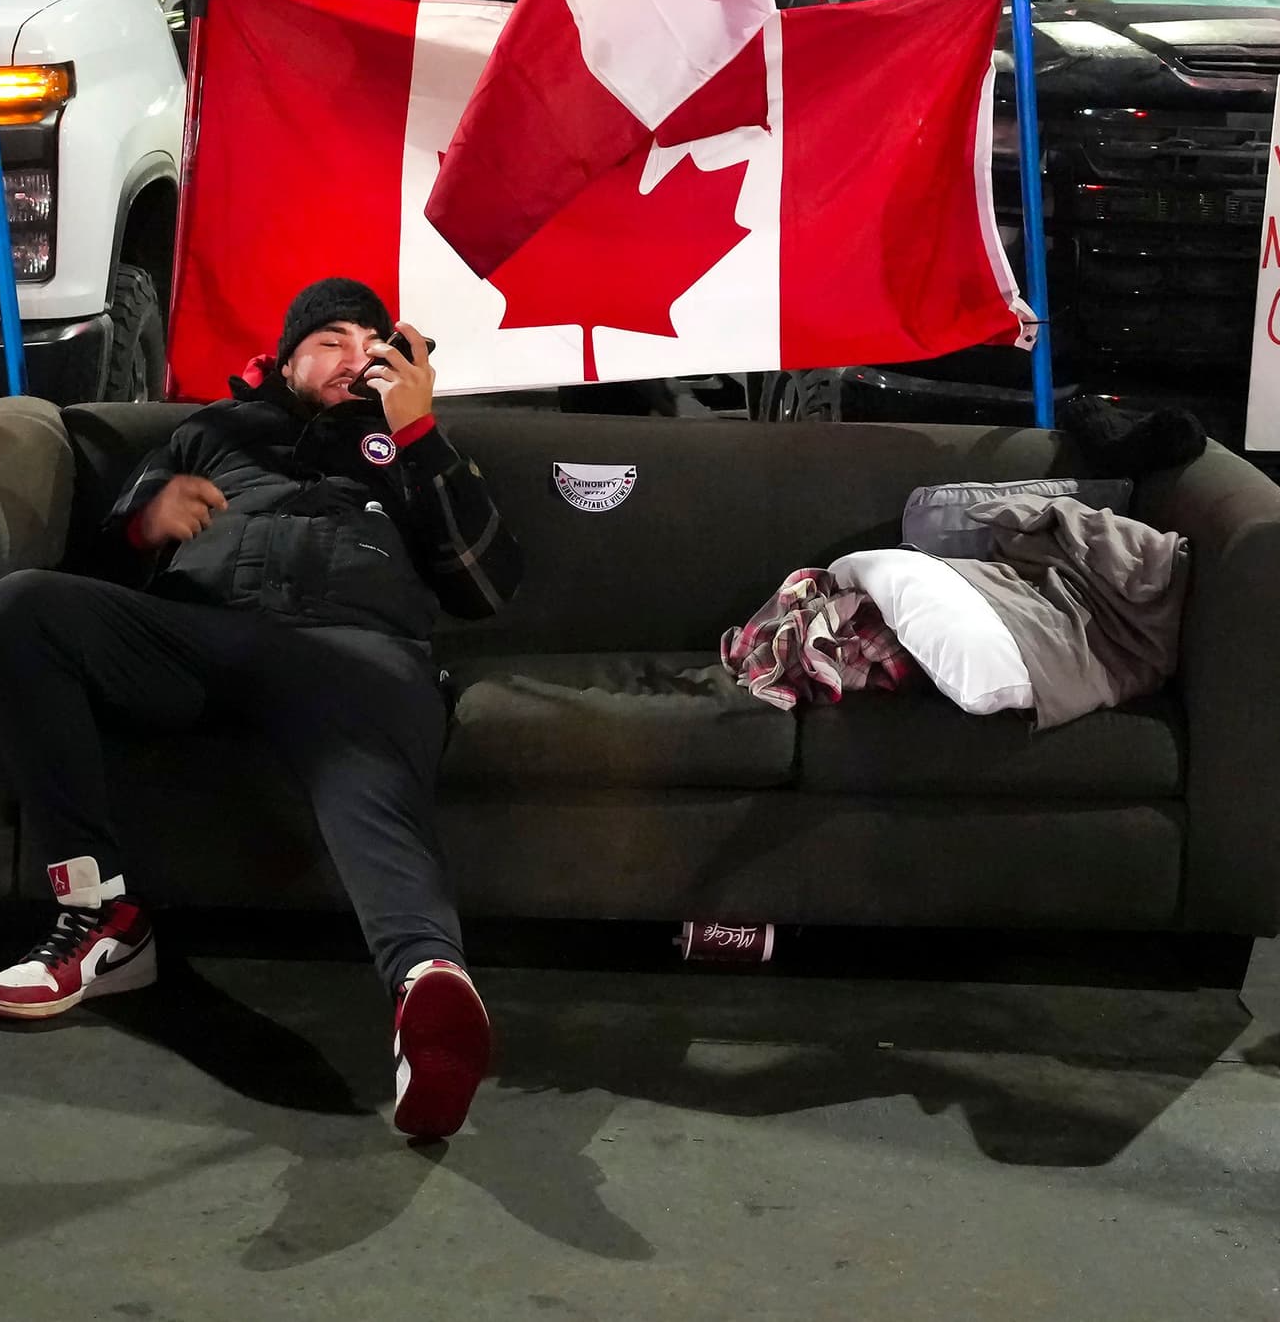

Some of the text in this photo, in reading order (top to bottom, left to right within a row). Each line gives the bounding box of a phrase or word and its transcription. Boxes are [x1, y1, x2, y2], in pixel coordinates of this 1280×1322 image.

[573, 480, 617, 488] MINORITY
[561, 484, 630, 509] UNACCEPTABLE VIEWS
